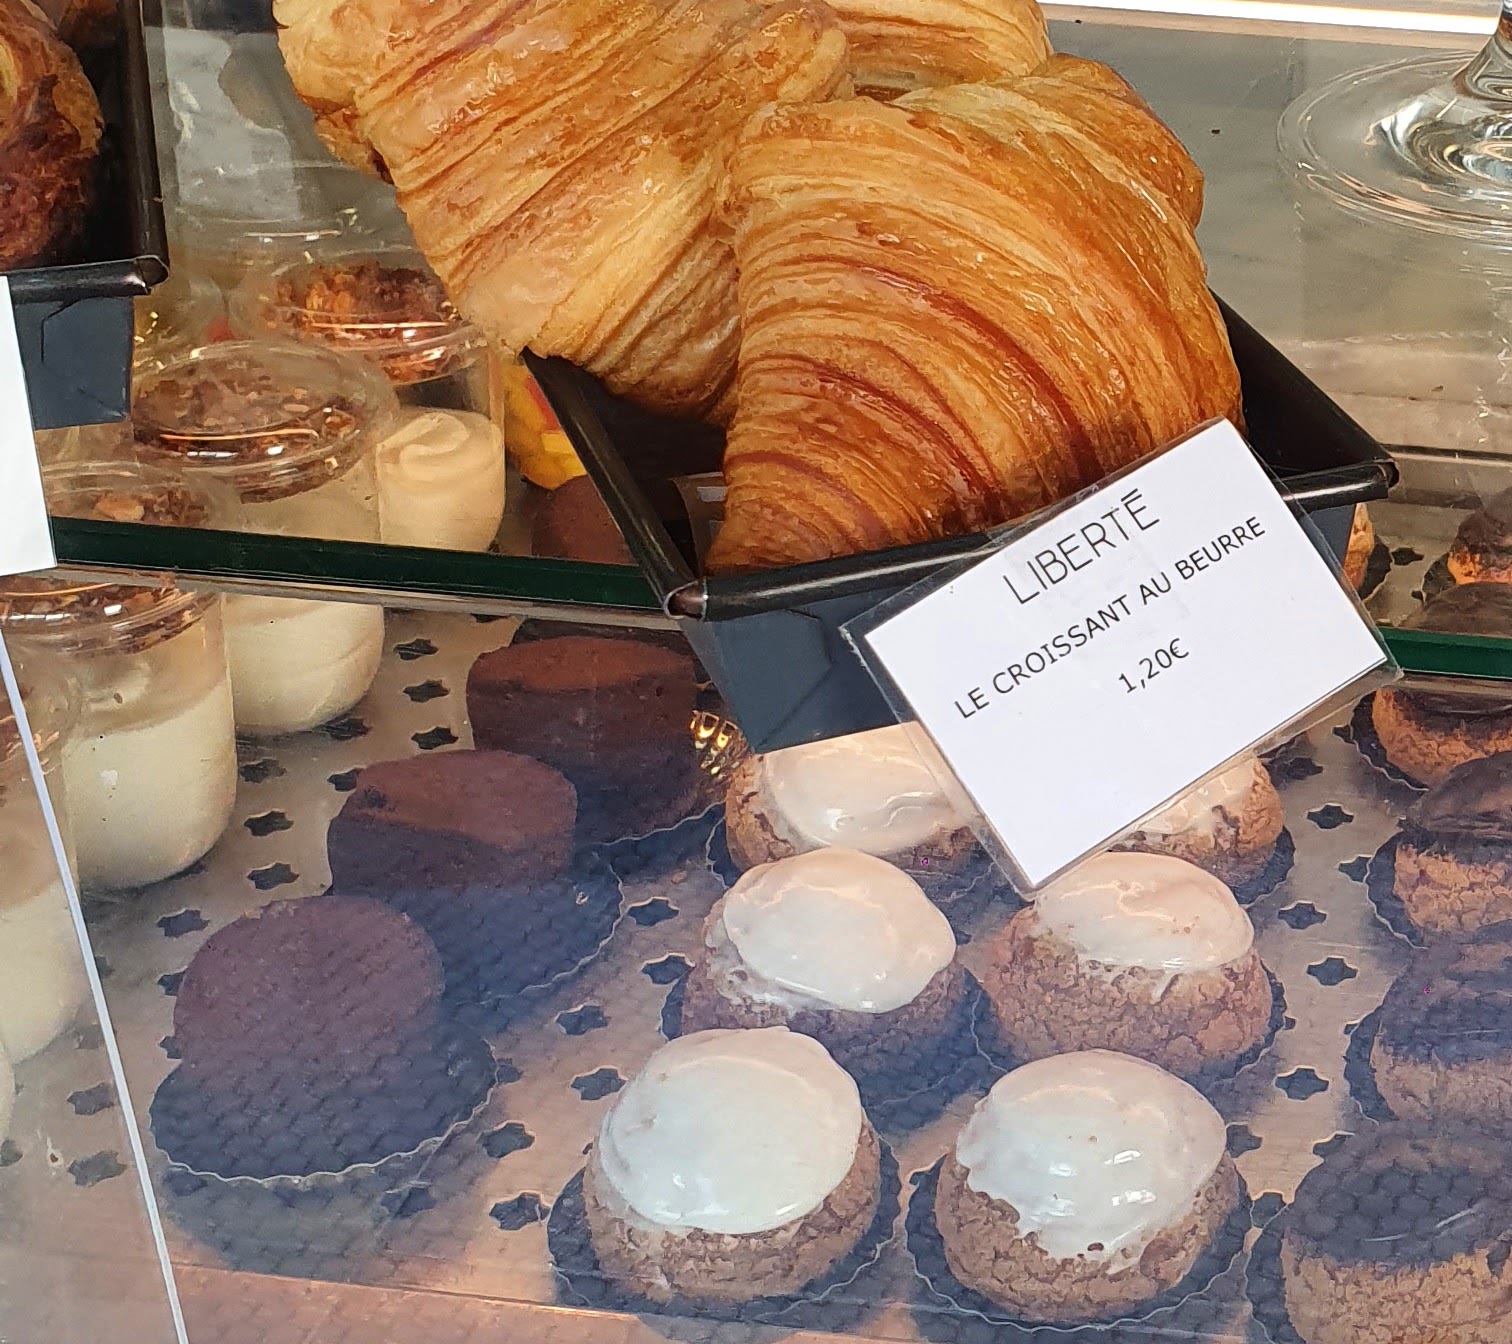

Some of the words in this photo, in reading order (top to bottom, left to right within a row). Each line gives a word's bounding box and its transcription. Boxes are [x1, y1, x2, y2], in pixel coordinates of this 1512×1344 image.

[1002, 487, 1160, 605] LIBERTÉ
[954, 687, 990, 719] LE
[992, 593, 1132, 696] CROISSANT
[1139, 572, 1172, 605] AU
[1174, 516, 1266, 581] BEURRE
[1117, 637, 1190, 694] 1,20€
